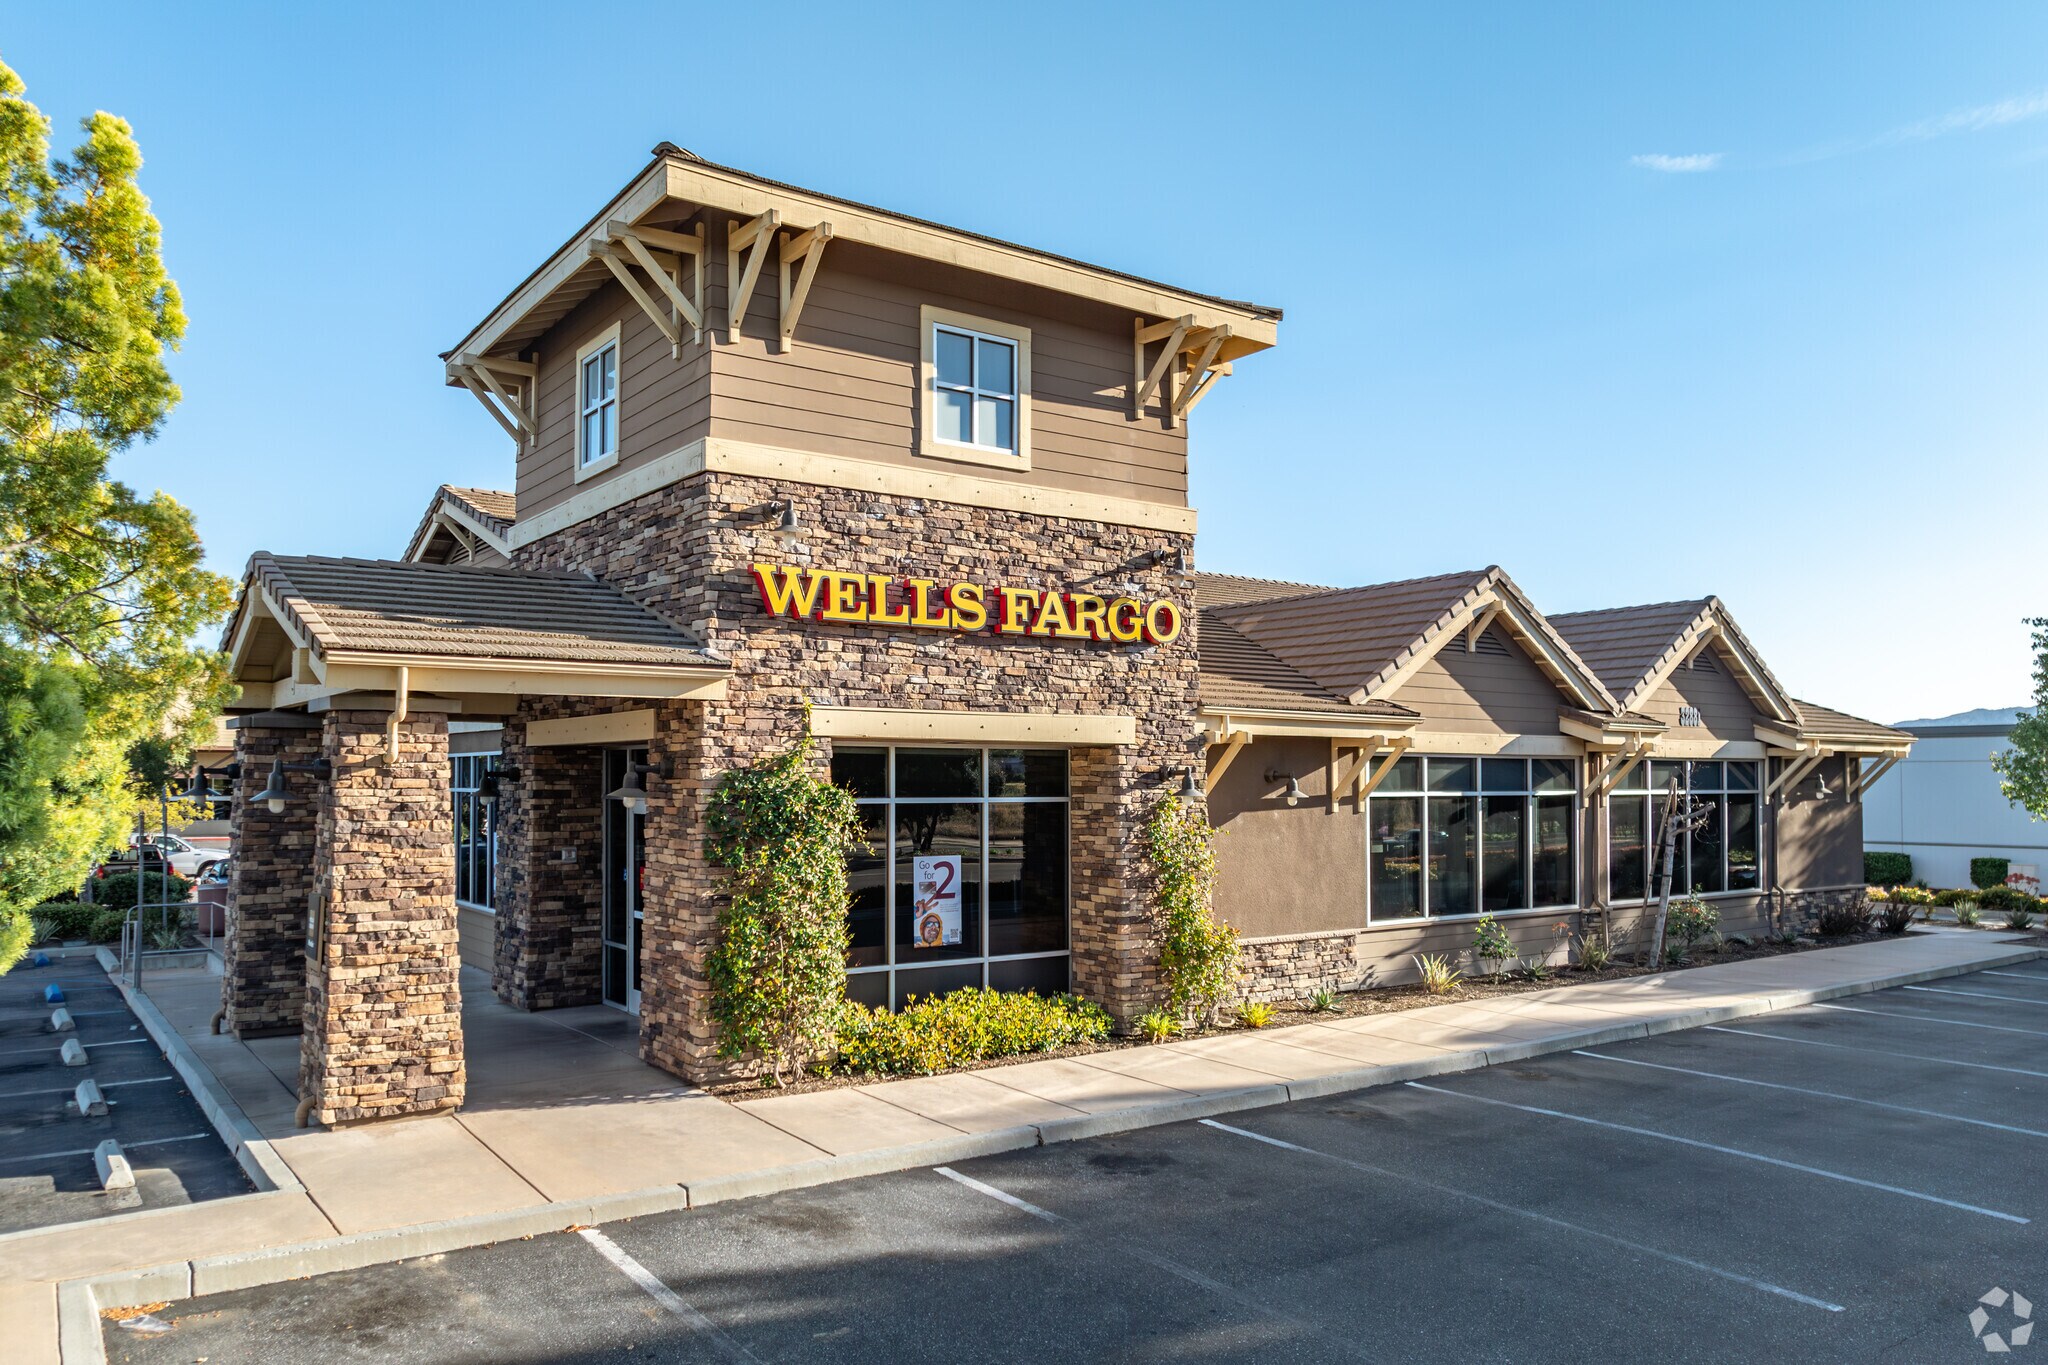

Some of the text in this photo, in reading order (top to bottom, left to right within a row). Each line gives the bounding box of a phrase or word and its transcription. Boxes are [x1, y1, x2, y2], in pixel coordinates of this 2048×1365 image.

[748, 563, 1183, 645] WELLS FARGO
[919, 860, 930, 870] Go
[924, 870, 934, 880] for
[933, 861, 956, 899] 2
